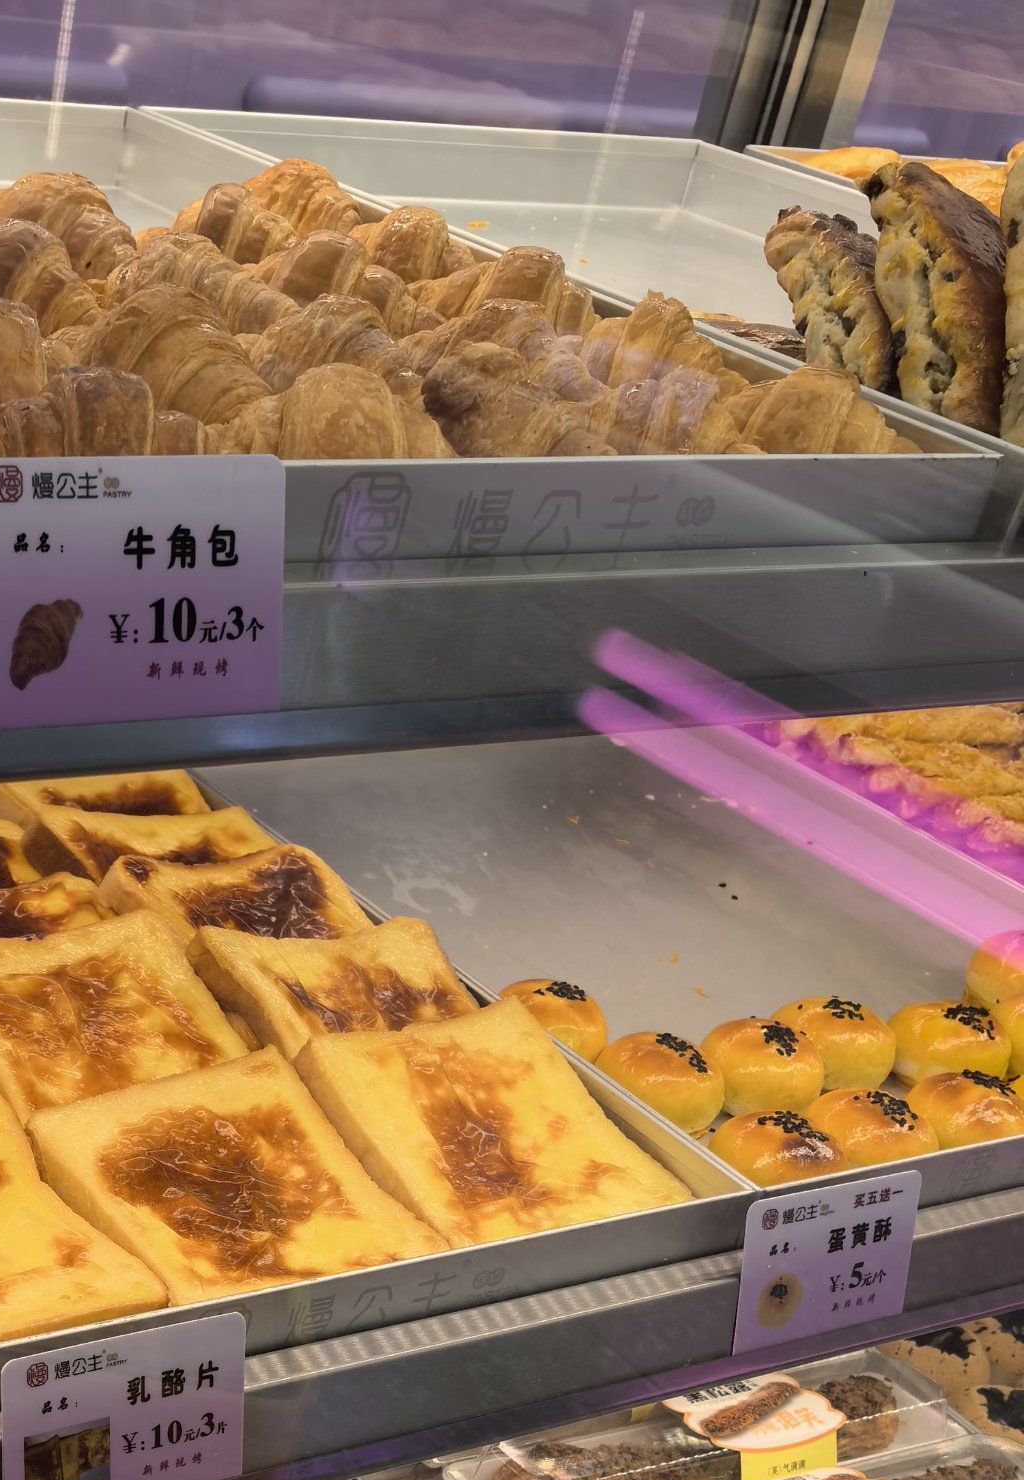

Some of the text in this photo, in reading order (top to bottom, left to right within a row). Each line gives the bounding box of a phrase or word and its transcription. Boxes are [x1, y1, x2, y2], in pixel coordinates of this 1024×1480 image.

[14, 524, 239, 569] 品名： 牛角包
[854, 1187, 903, 1208] 买五送一
[827, 1216, 892, 1253] 蛋黄酥
[126, 1360, 219, 1405] 乳酪片
